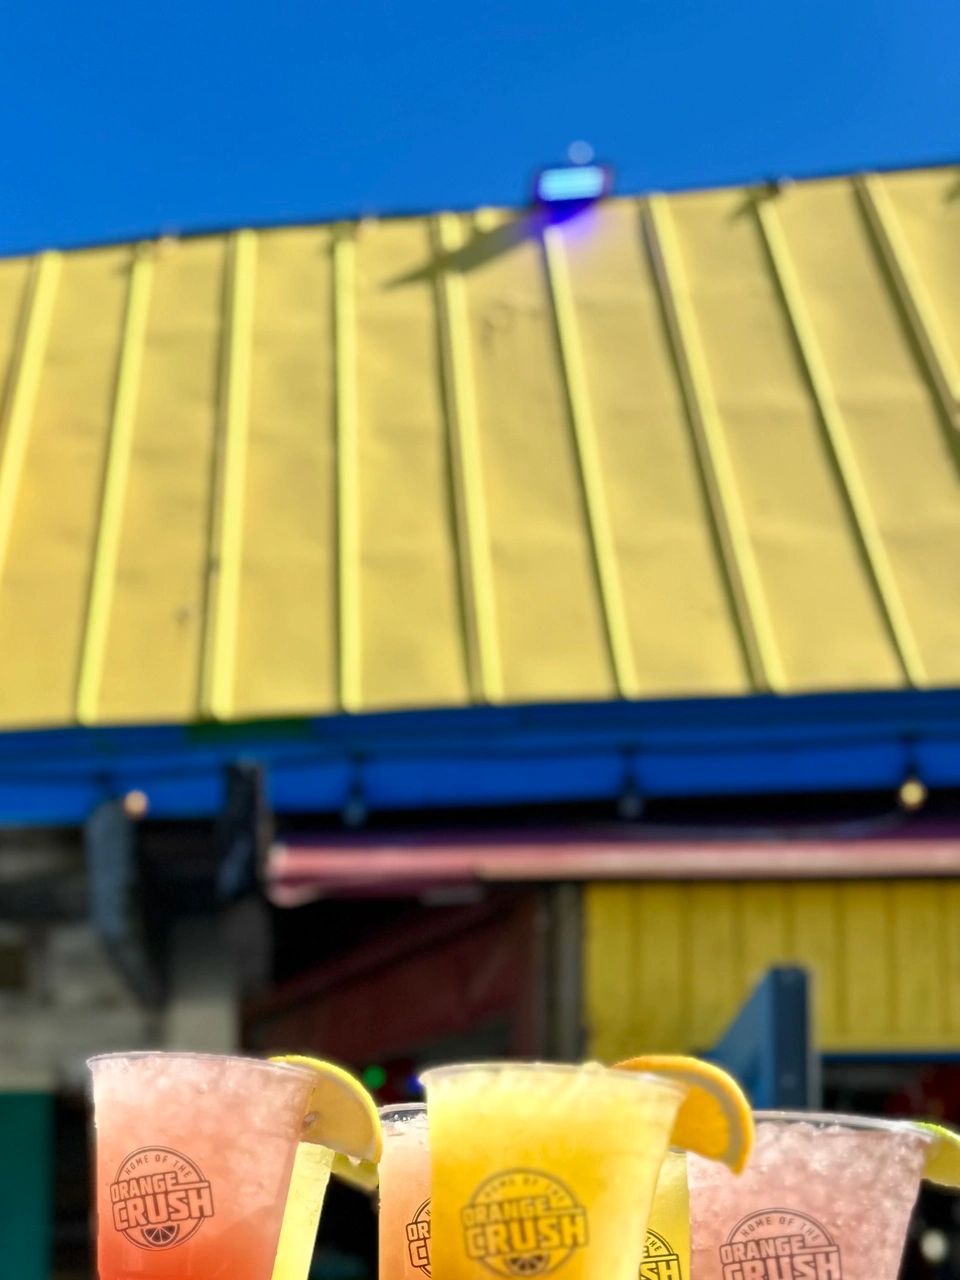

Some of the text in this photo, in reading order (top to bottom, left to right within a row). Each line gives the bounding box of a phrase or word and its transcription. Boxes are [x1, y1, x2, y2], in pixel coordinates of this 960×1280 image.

[124, 1153, 193, 1179] HOME OF THE
[110, 1171, 211, 1203] ORANGE
[112, 1187, 215, 1232] CRUSH
[461, 1195, 587, 1228] ORANGE
[463, 1213, 590, 1260] CRUSH
[740, 1216, 820, 1242] HOME OF THE
[720, 1234, 840, 1265] ORANGE
